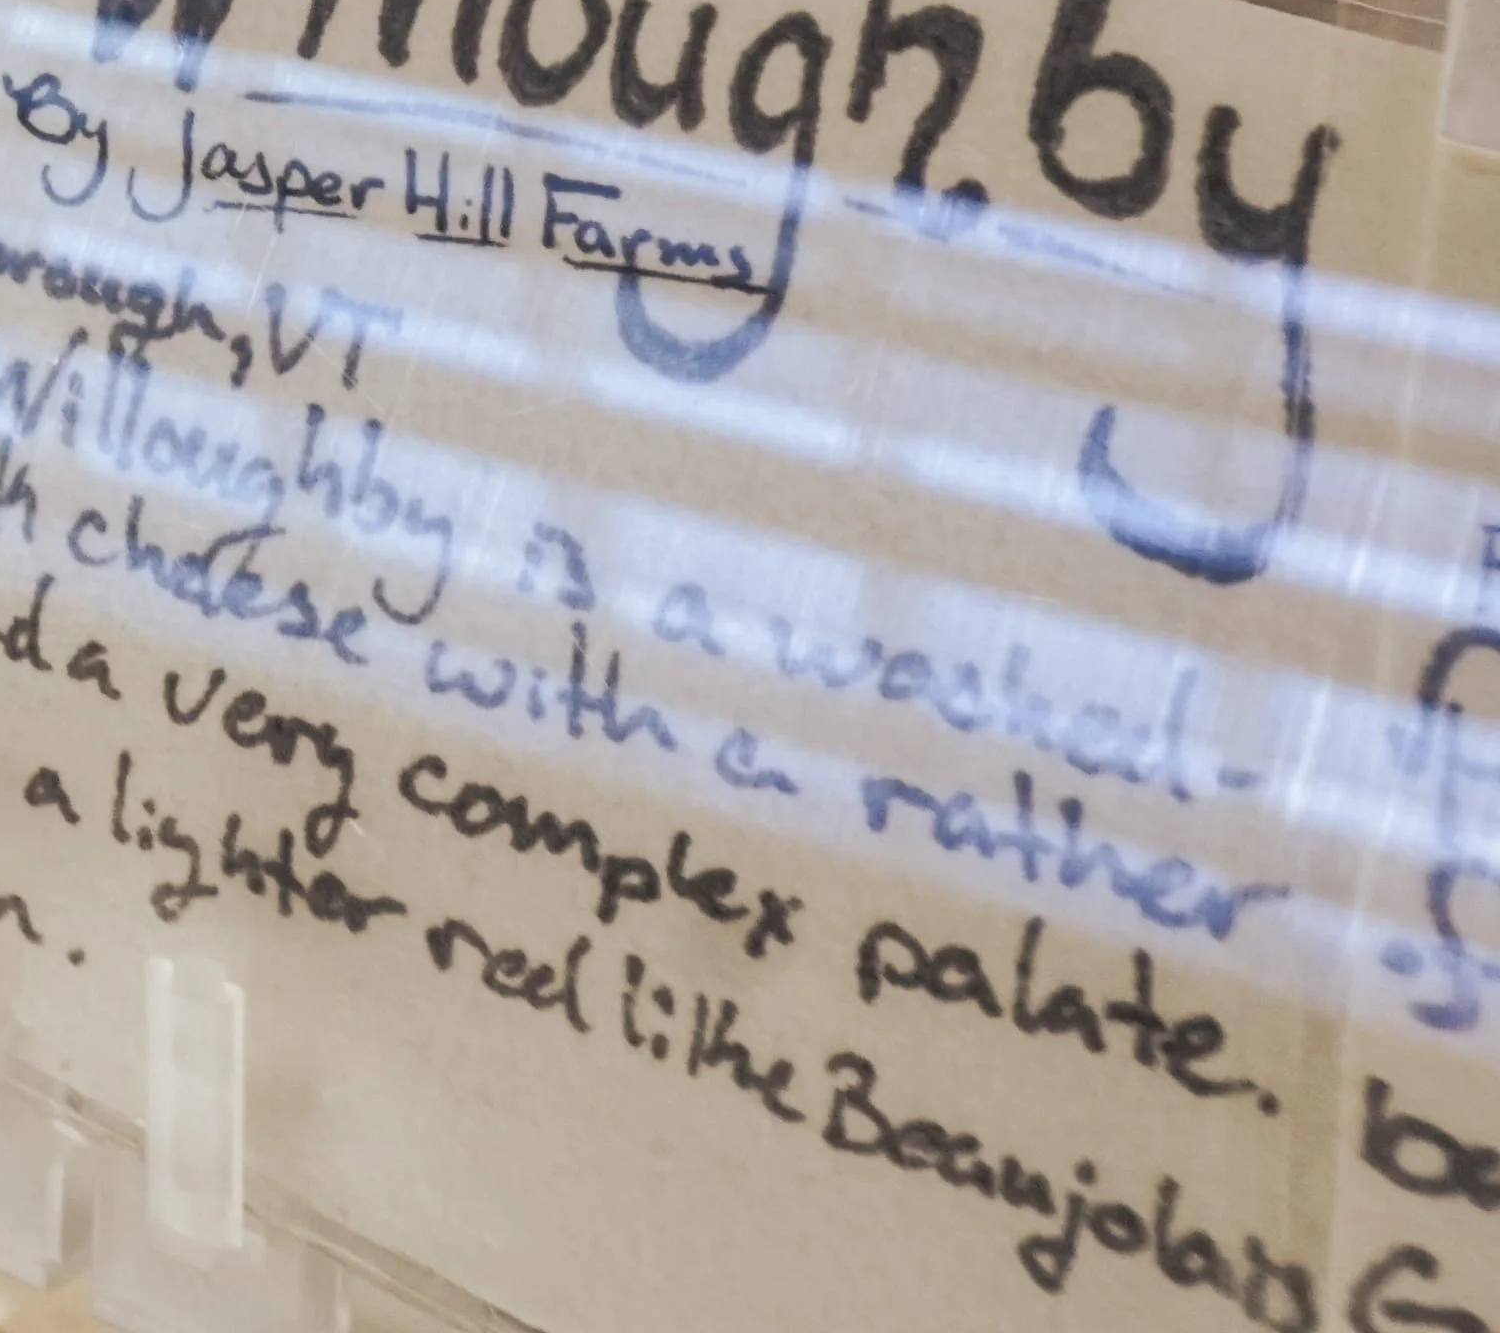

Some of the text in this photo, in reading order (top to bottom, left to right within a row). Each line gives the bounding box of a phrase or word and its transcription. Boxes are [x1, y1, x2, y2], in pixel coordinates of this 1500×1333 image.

[2, 72, 755, 285] By Jasper Hill Farms
[266, 283, 403, 388] VT
[650, 579, 728, 657] a
[24, 767, 80, 826] a
[110, 749, 407, 932] lighter
[426, 917, 594, 1035] red
[65, 638, 122, 701] a
[162, 667, 359, 857] very
[398, 753, 806, 959] complex
[857, 917, 1281, 1117] palate.
[425, 622, 678, 750] with
[712, 726, 802, 797] a
[860, 769, 1296, 941] rather
